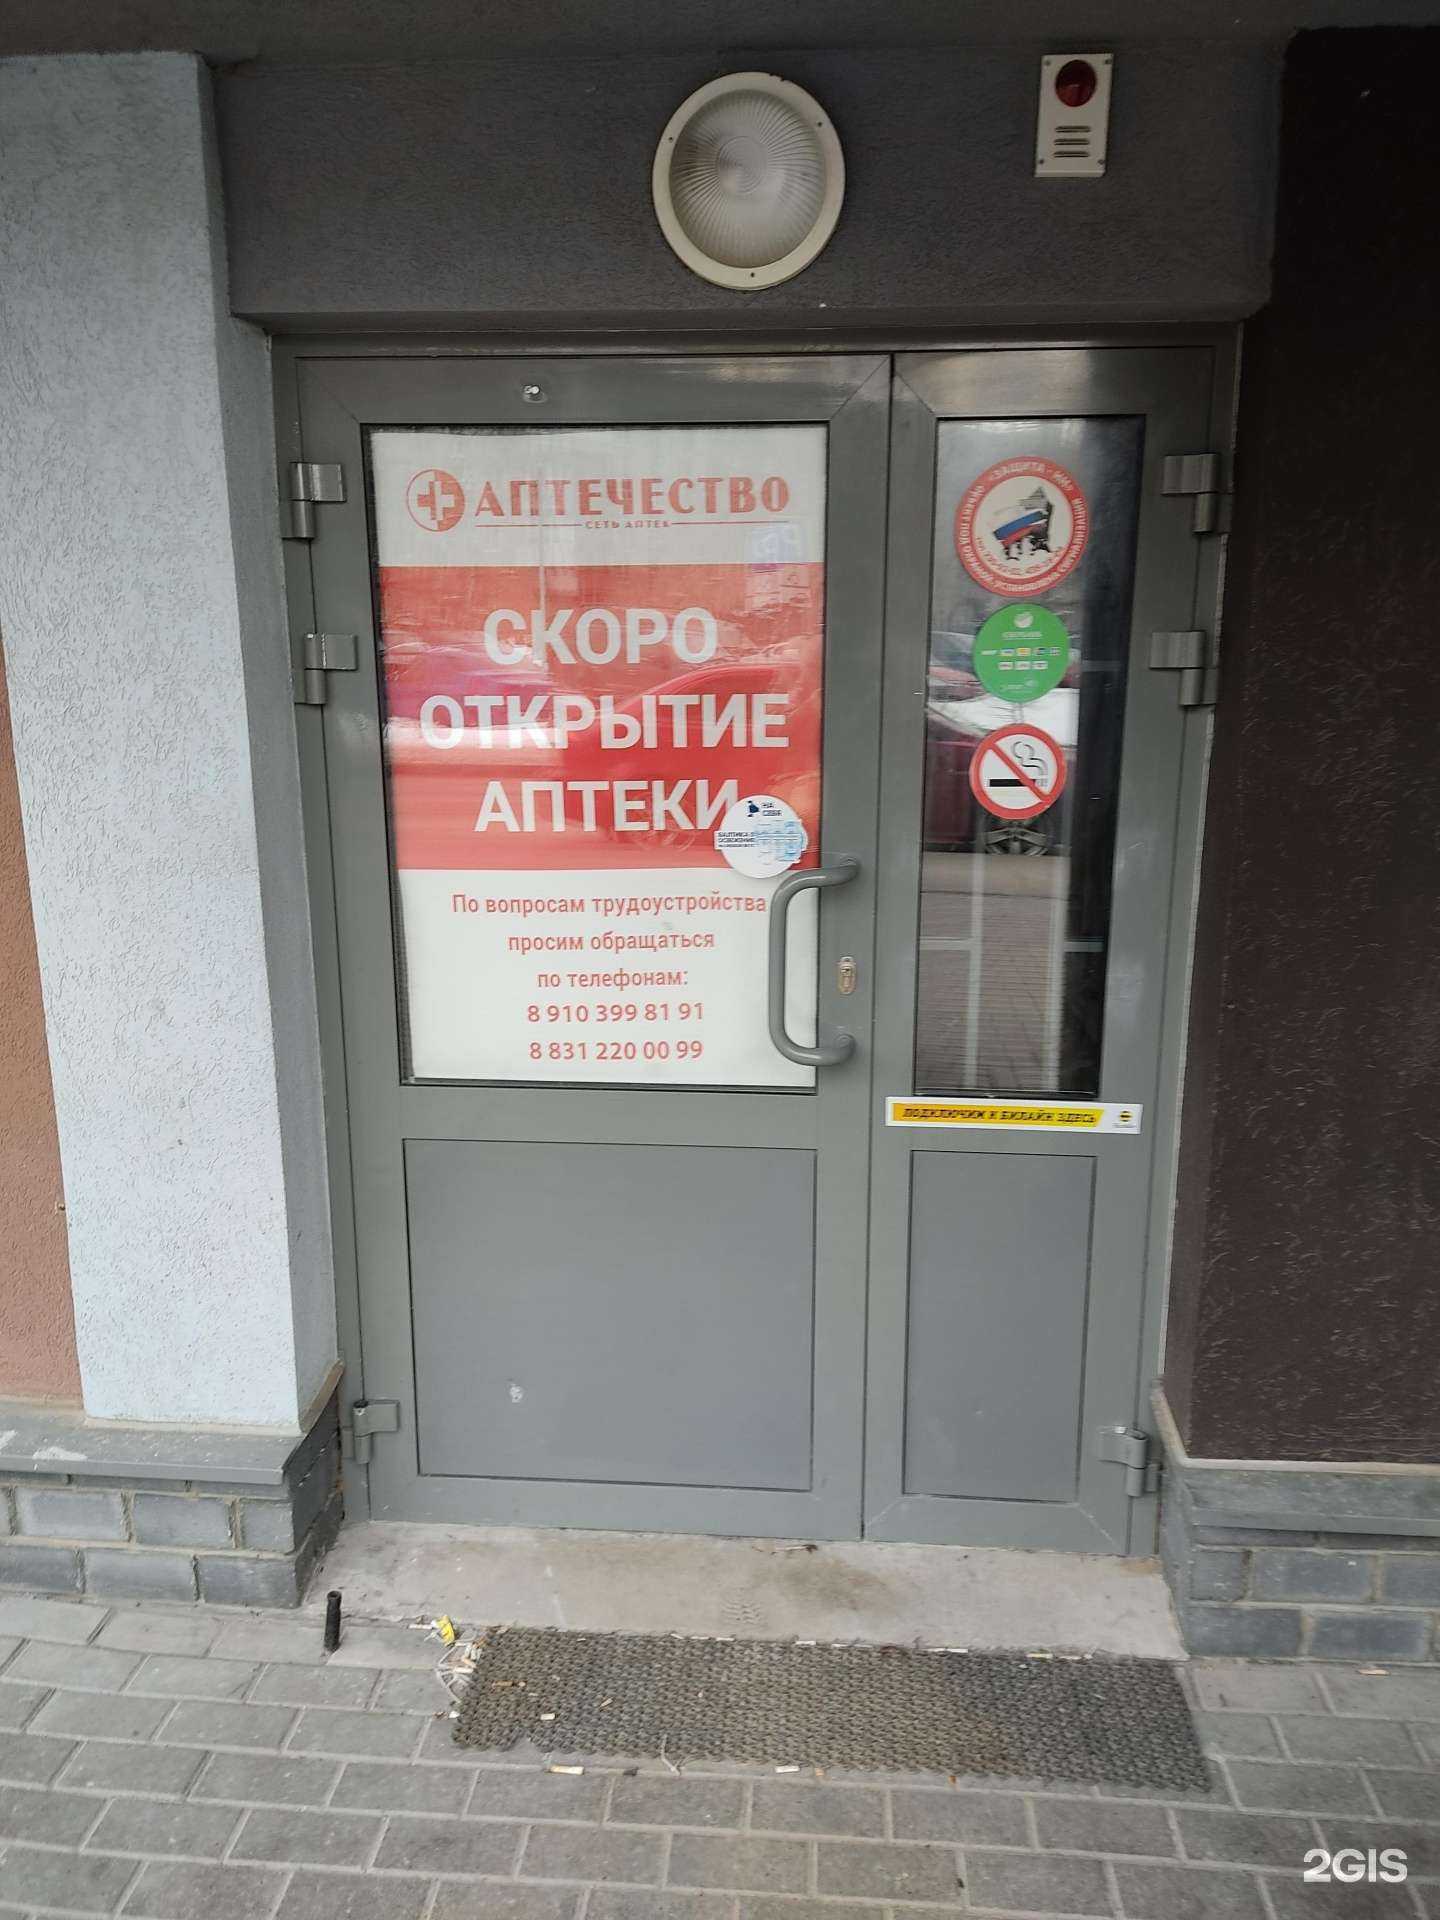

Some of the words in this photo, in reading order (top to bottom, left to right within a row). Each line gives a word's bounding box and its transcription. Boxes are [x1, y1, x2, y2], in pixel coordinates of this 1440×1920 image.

[475, 476, 790, 516] АПТЕЧЕСТВО
[483, 607, 718, 665] СКОРО
[419, 693, 790, 750] ОТКРЫТИЕ
[474, 780, 738, 832] АПТЕКИ
[452, 894, 479, 913] По
[486, 895, 584, 917] вопросам
[592, 891, 767, 916] трудоустройства
[508, 936, 584, 955] просим
[590, 930, 715, 953] обращаться
[537, 974, 561, 988] по
[567, 968, 689, 990] телефонам:
[527, 1006, 538, 1022] 8
[547, 1006, 589, 1022] 910
[596, 1005, 637, 1021] 399
[645, 1004, 669, 1021] 81
[679, 1003, 704, 1020] 91
[529, 1043, 541, 1060] 8
[549, 1043, 588, 1060] 831
[596, 1043, 636, 1060] 220
[643, 1042, 670, 1059] 00
[677, 1041, 703, 1059] 99
